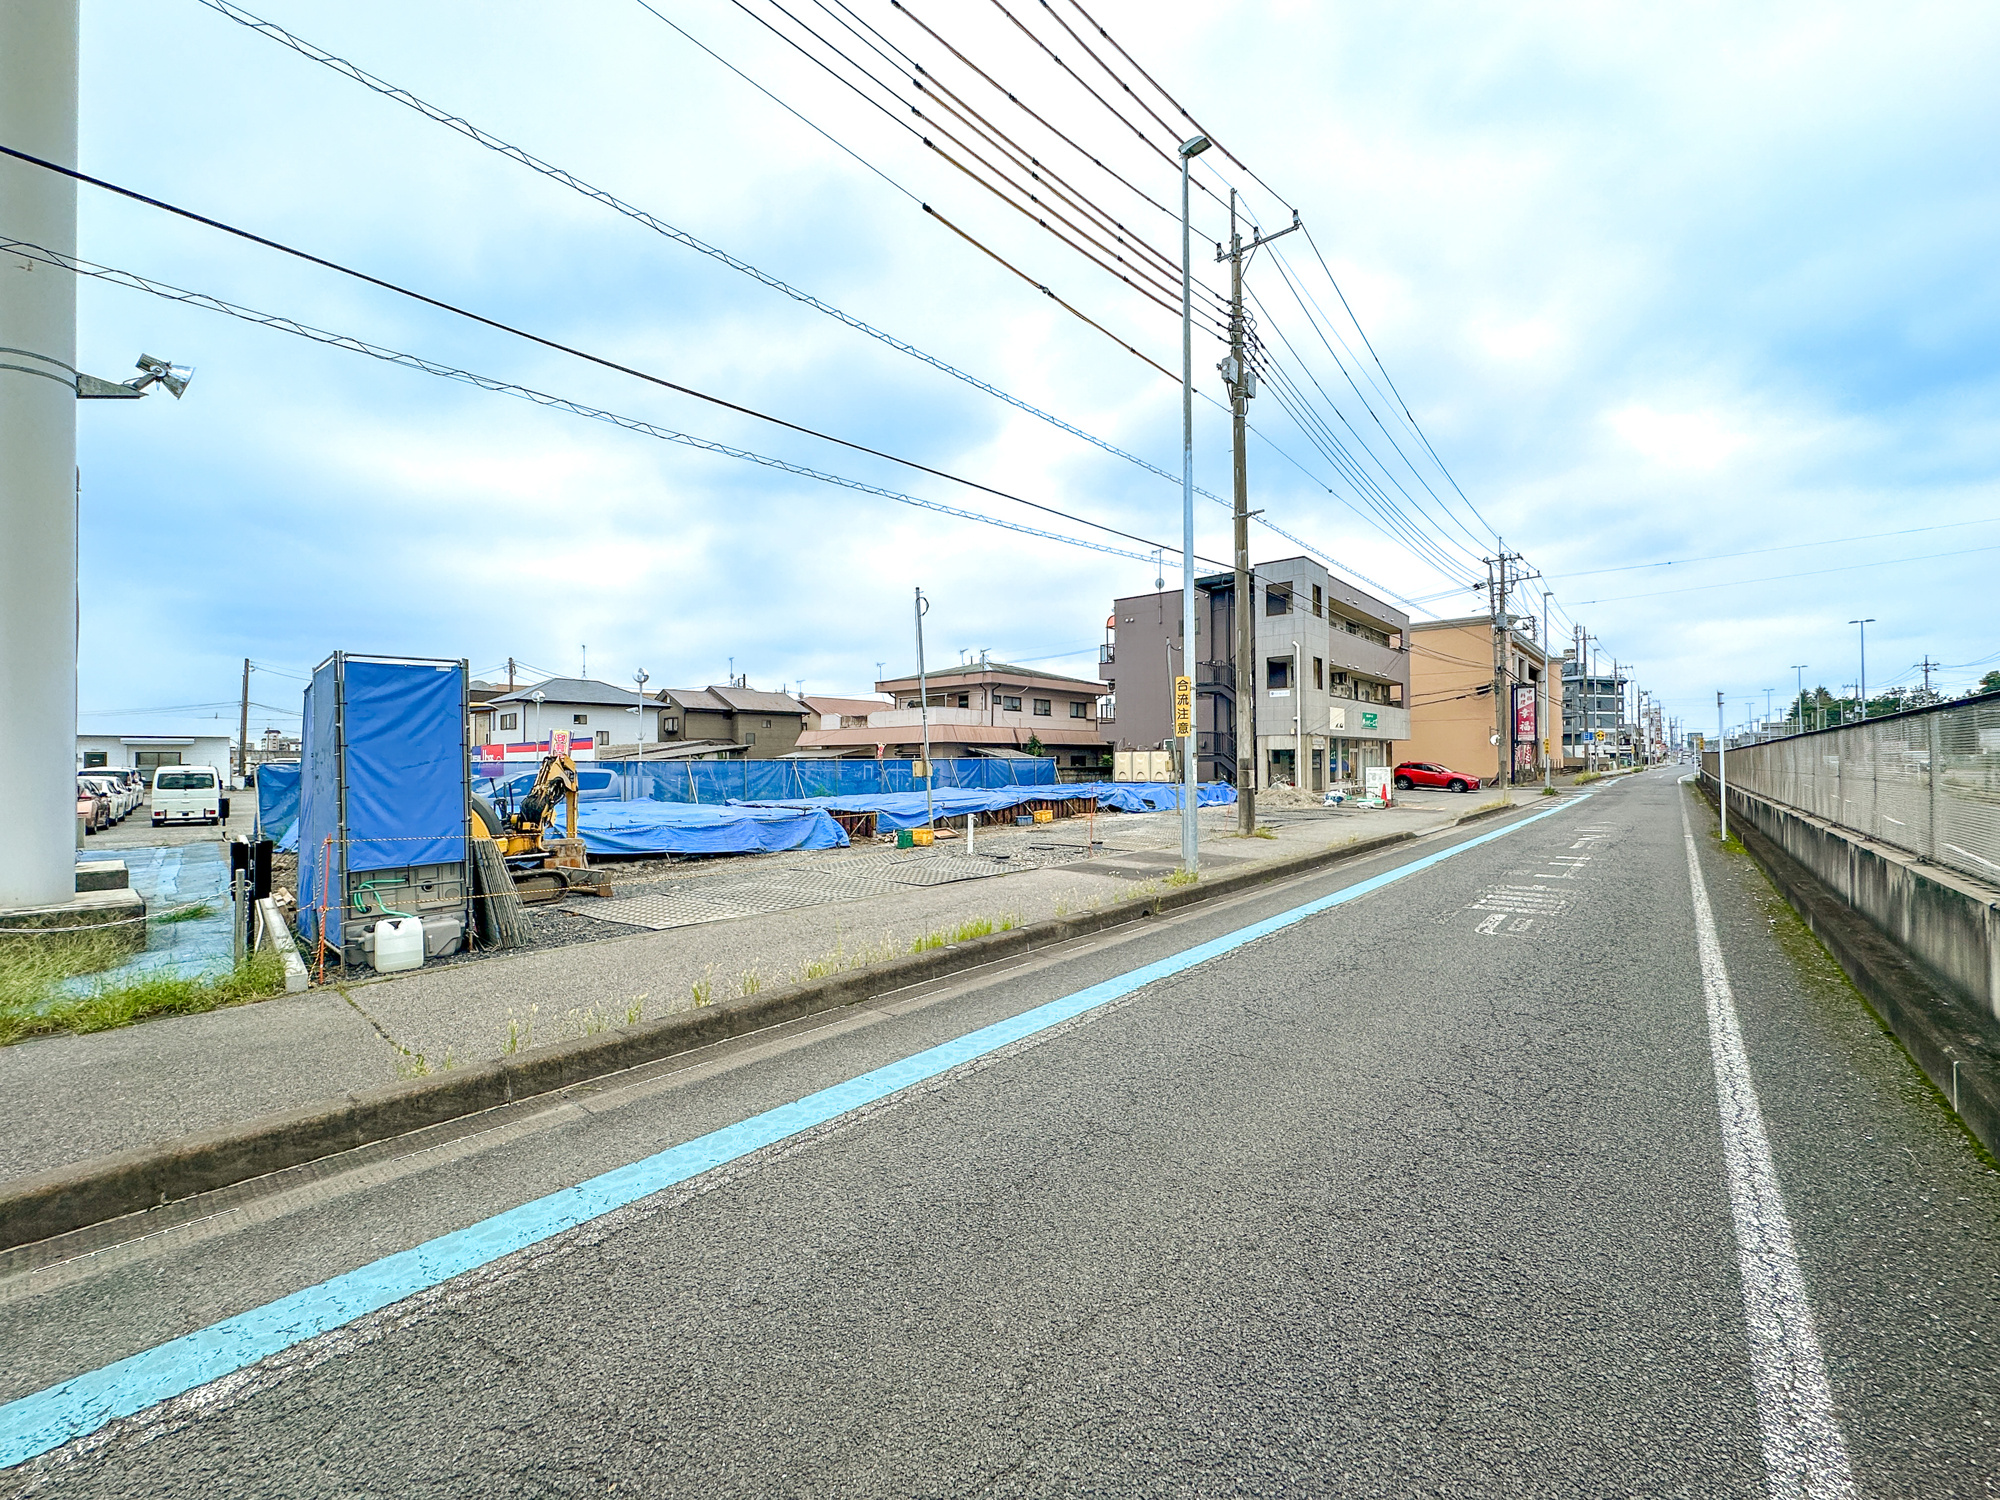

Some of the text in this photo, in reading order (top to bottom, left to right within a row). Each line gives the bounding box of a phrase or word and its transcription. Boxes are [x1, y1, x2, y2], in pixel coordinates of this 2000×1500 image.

[1177, 679, 1189, 734] 合流注意
[1520, 708, 1530, 731] 幸福
